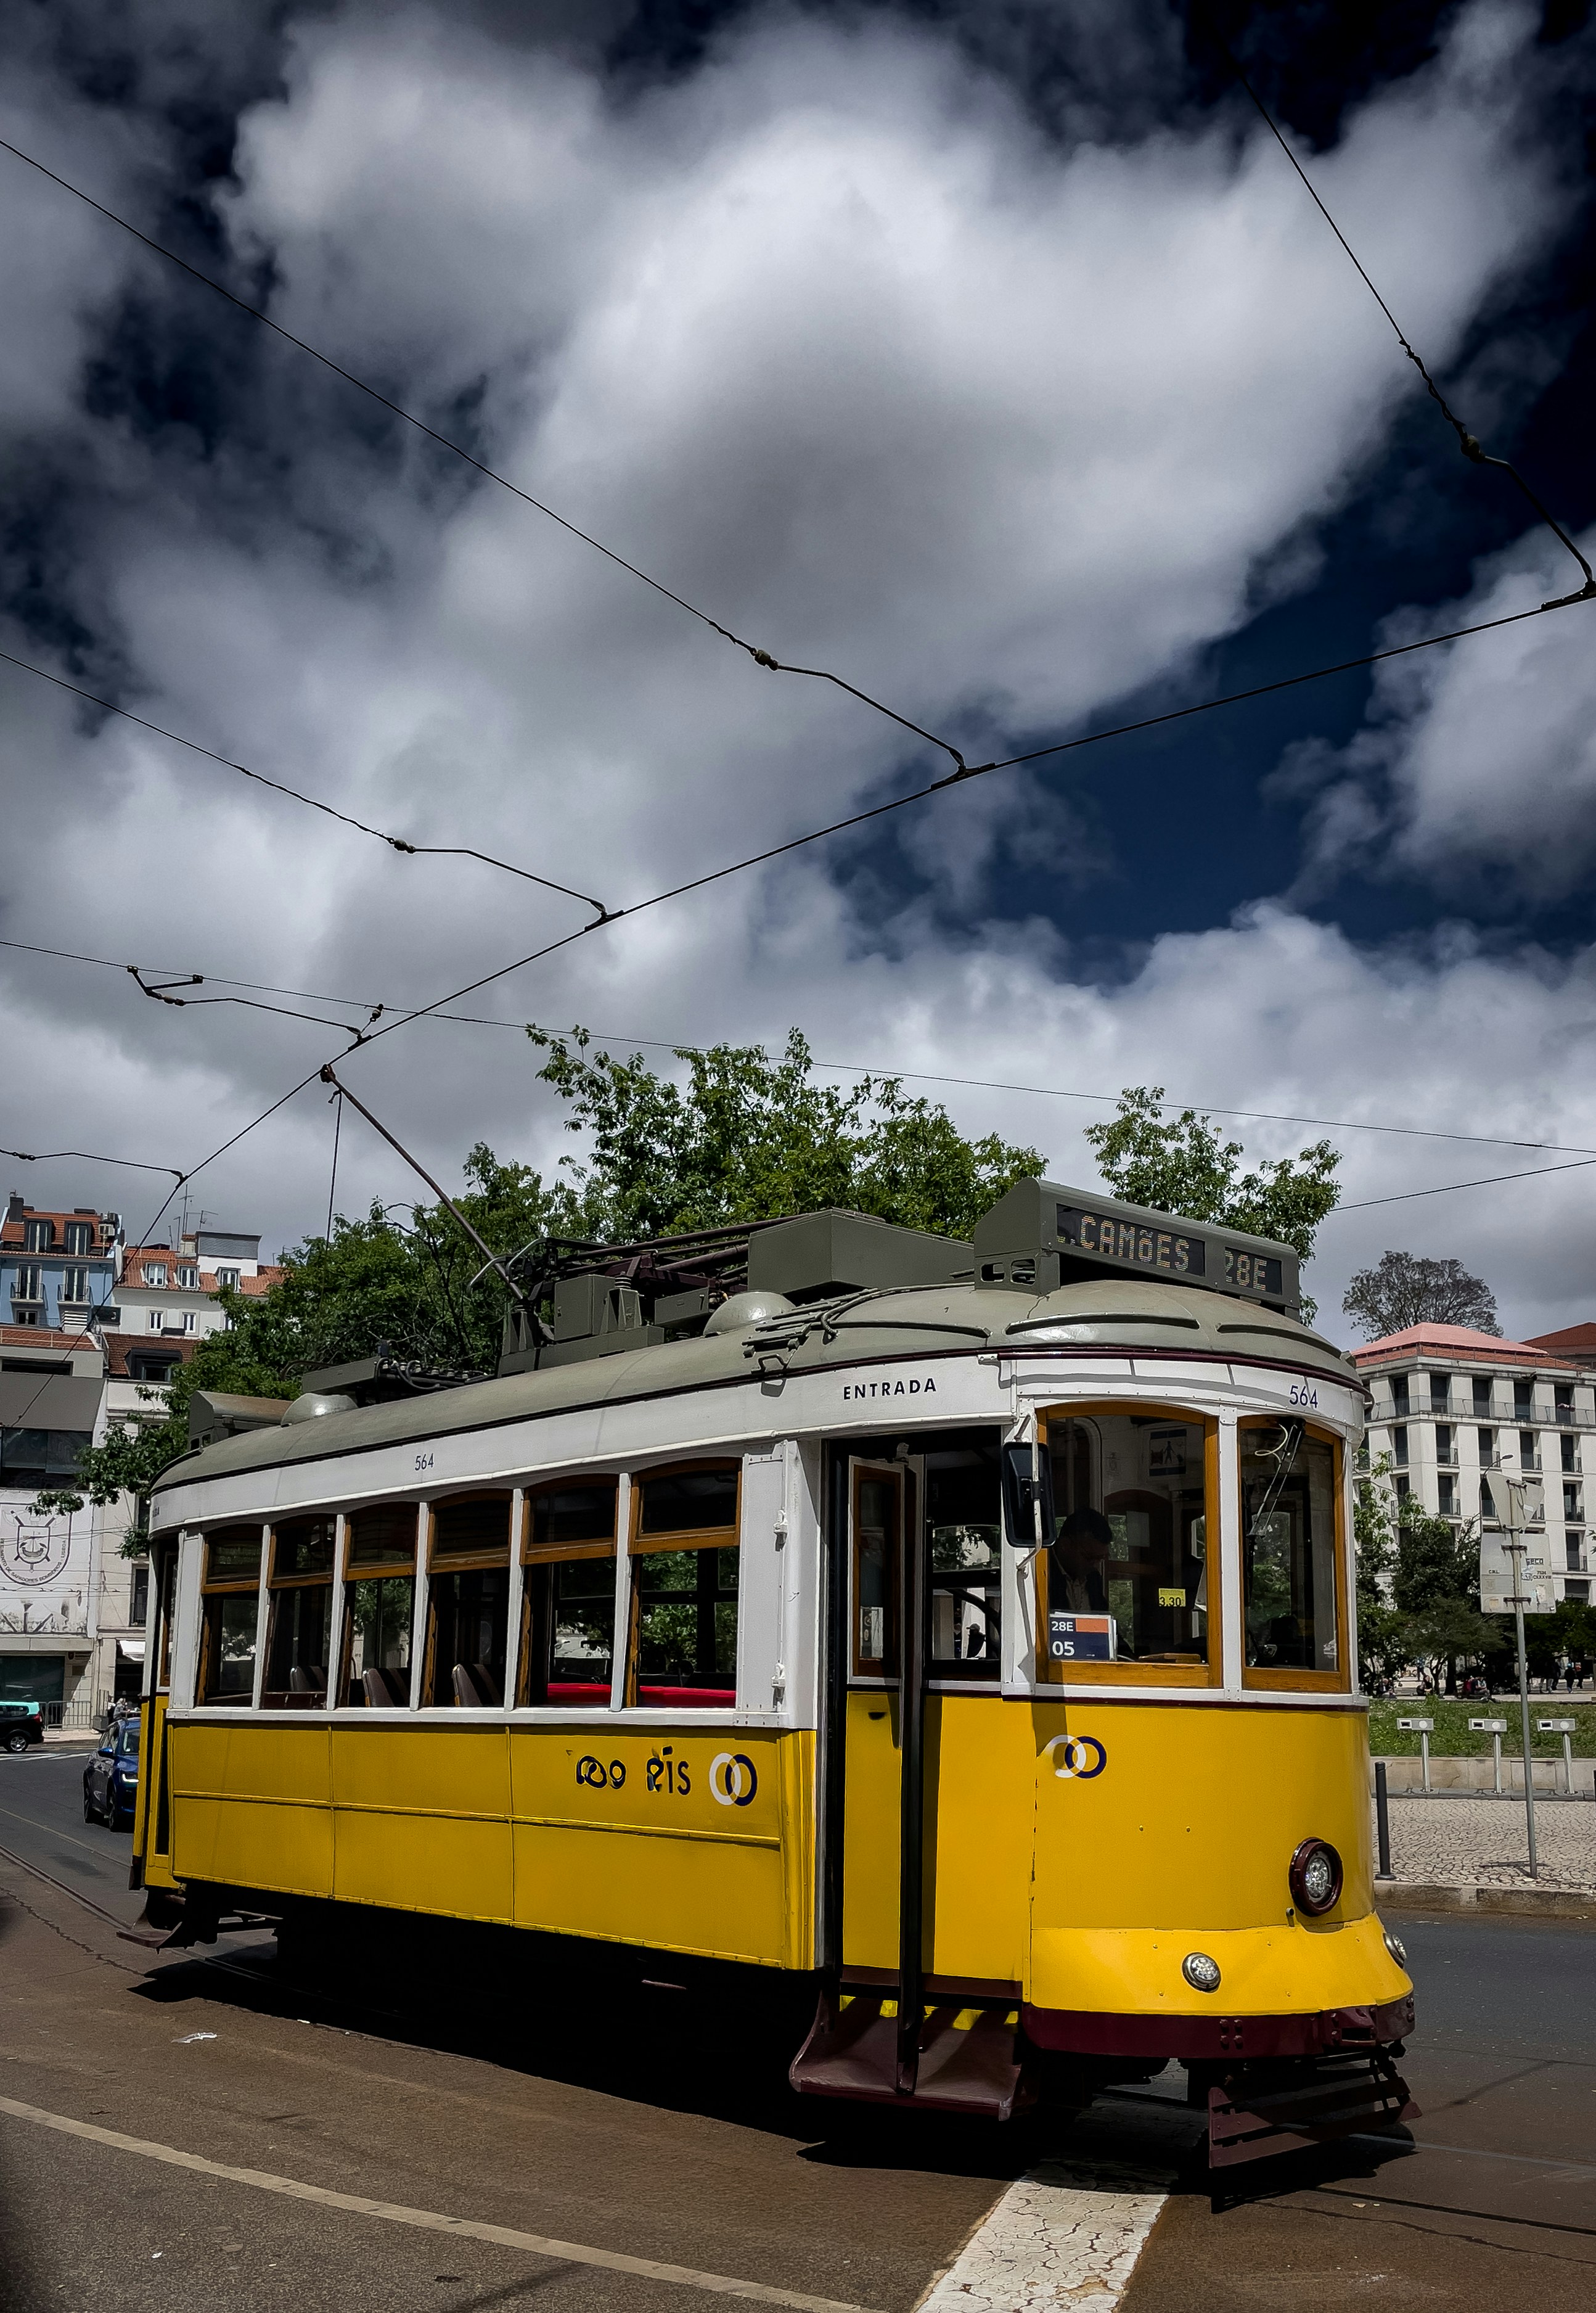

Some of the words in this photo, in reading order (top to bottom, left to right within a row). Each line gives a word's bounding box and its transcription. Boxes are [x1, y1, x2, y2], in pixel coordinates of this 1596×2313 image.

[1224, 1250, 1267, 1291] 28E
[843, 1378, 937, 1400] ENTRADA
[1289, 1384, 1319, 1409] 564
[414, 1452, 434, 1471] 564
[1051, 1621, 1074, 1632] 28E
[1052, 1640, 1075, 1656] 05
